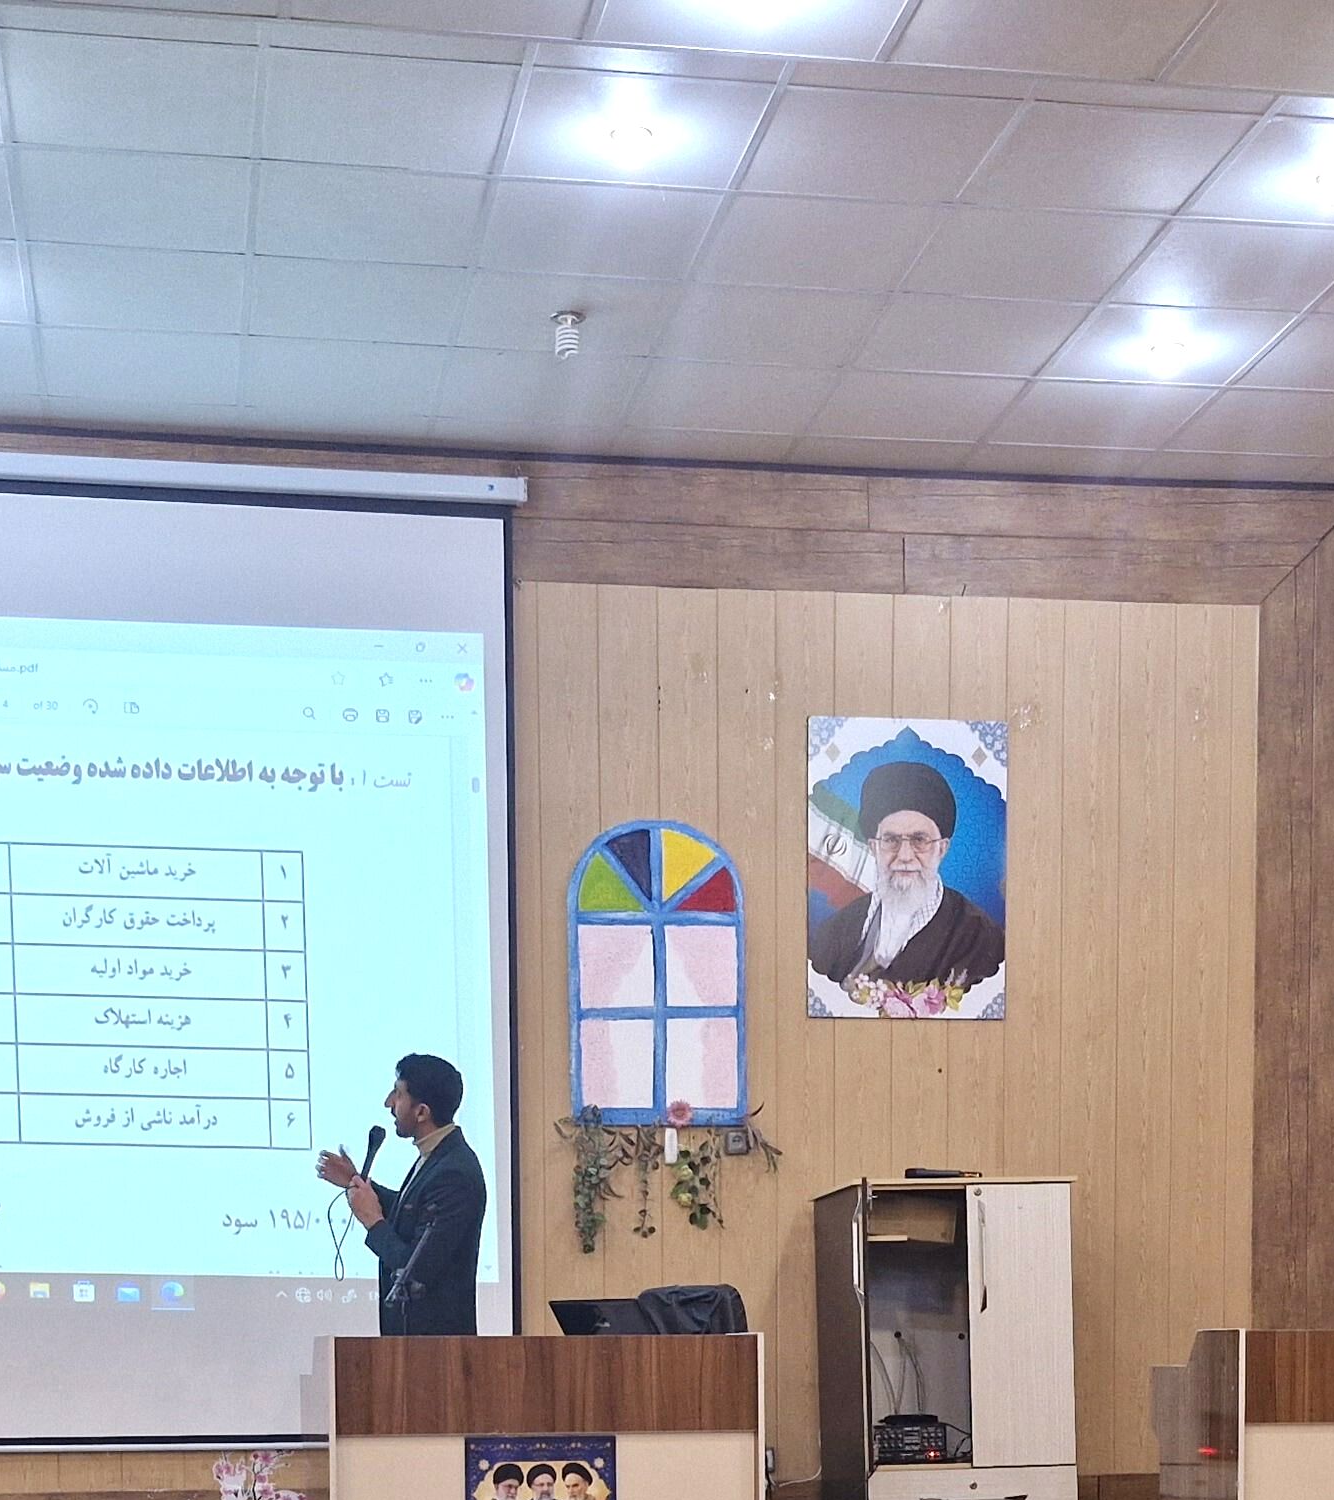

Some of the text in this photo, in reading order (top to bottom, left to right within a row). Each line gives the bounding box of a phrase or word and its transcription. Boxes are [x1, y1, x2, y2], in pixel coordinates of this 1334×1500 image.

[47, 700, 59, 710] 30
[16, 755, 82, 784] وضعیت
[87, 756, 126, 778] شده
[131, 757, 172, 780] داده
[178, 758, 253, 782] اطلاعات
[259, 766, 276, 789] به
[281, 763, 325, 792] توجه
[330, 763, 344, 792] با
[79, 853, 196, 882] خرید ماشین آلات
[63, 904, 215, 934] پرداخت حقوق کارگران
[281, 915, 288, 929] ۲
[91, 958, 192, 981] خرید مواد اولیه
[281, 965, 291, 979] ۳
[95, 1007, 191, 1031] هزینه استهلاک
[284, 1013, 292, 1029] ۴
[103, 1054, 187, 1079] اجاره کارگاه
[285, 1063, 294, 1079] ۵
[75, 1108, 115, 1128] فروش
[122, 1107, 134, 1128] از
[141, 1108, 172, 1131] ناشی
[287, 1112, 295, 1128] ۶
[223, 1214, 257, 1235] سود
